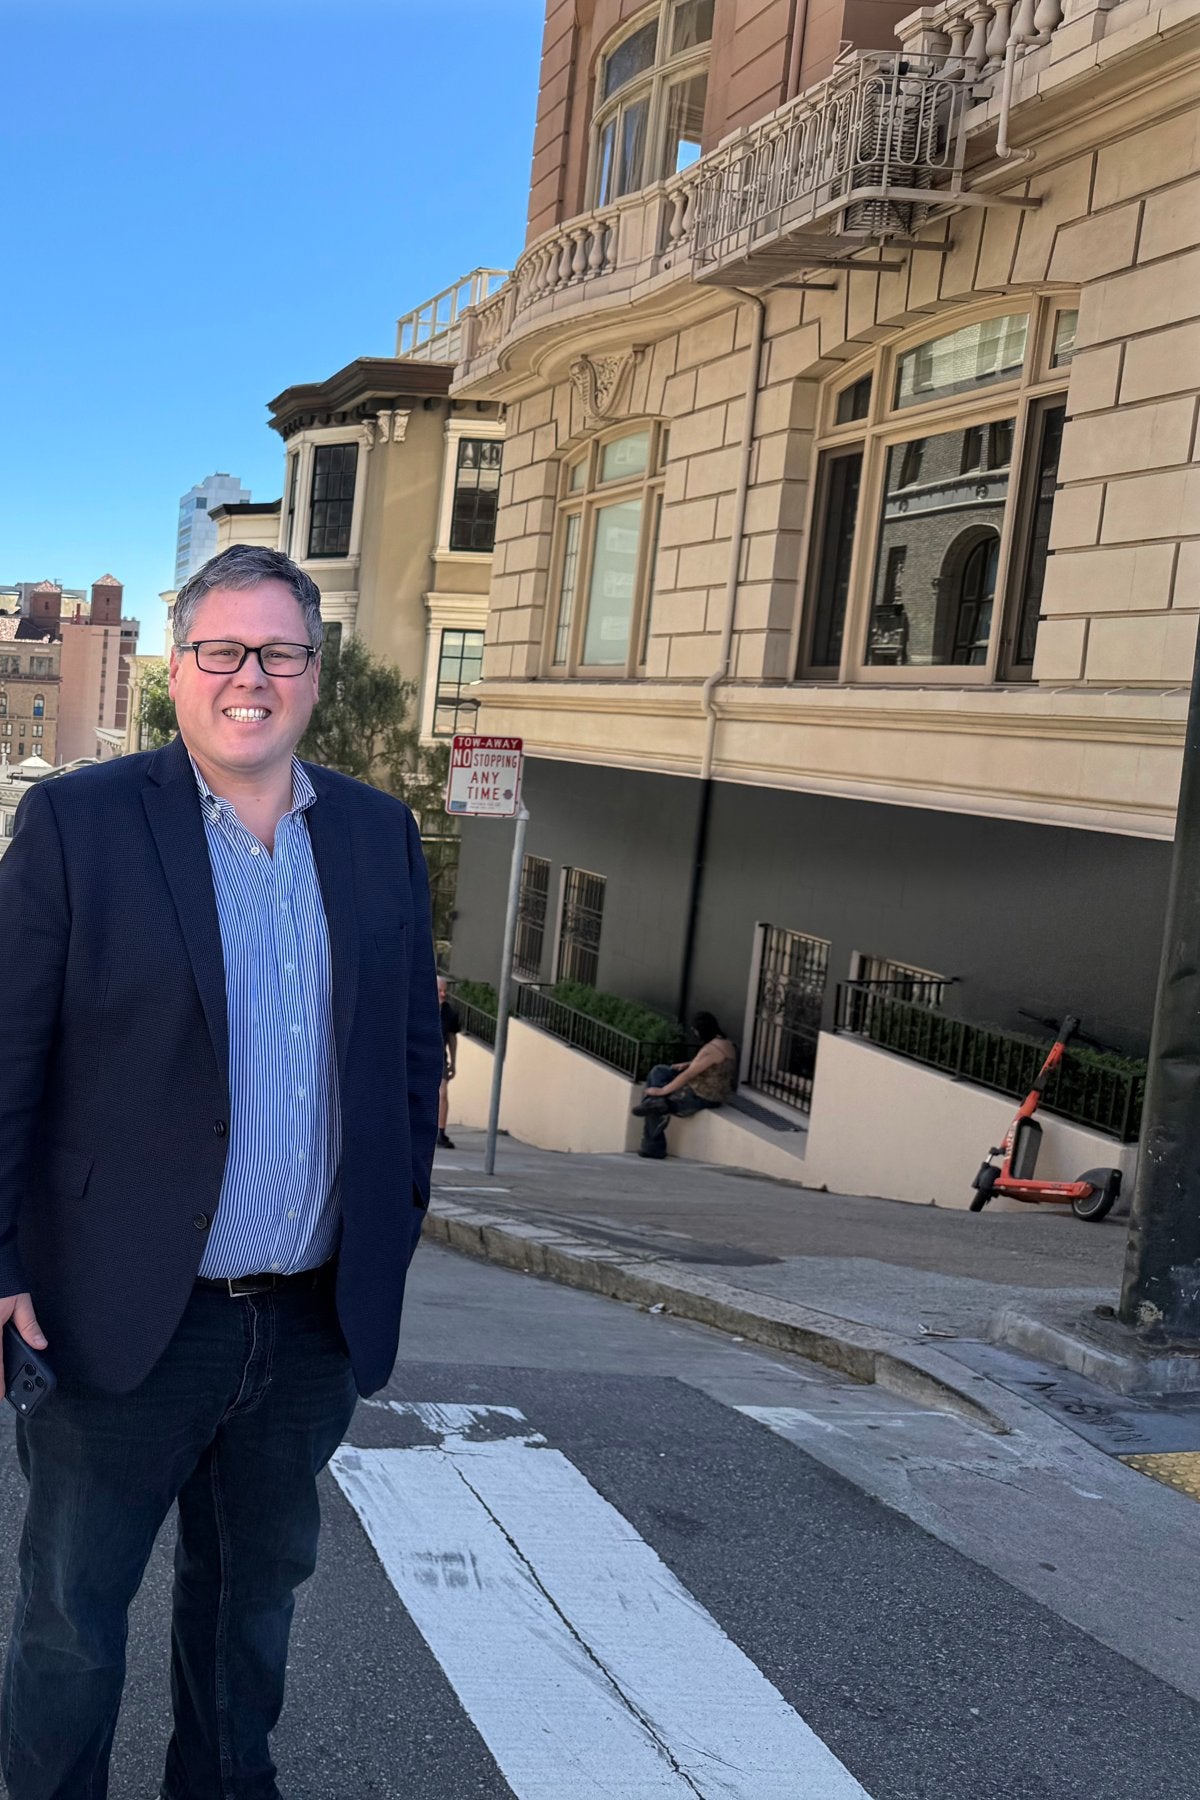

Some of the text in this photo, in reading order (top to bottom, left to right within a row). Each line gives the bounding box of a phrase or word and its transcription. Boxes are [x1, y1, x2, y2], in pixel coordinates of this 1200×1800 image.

[458, 737, 519, 749] TOW-AWAY
[453, 749, 518, 768] NO STOPPING
[470, 771, 500, 785] ANY
[467, 786, 501, 800] TIME
